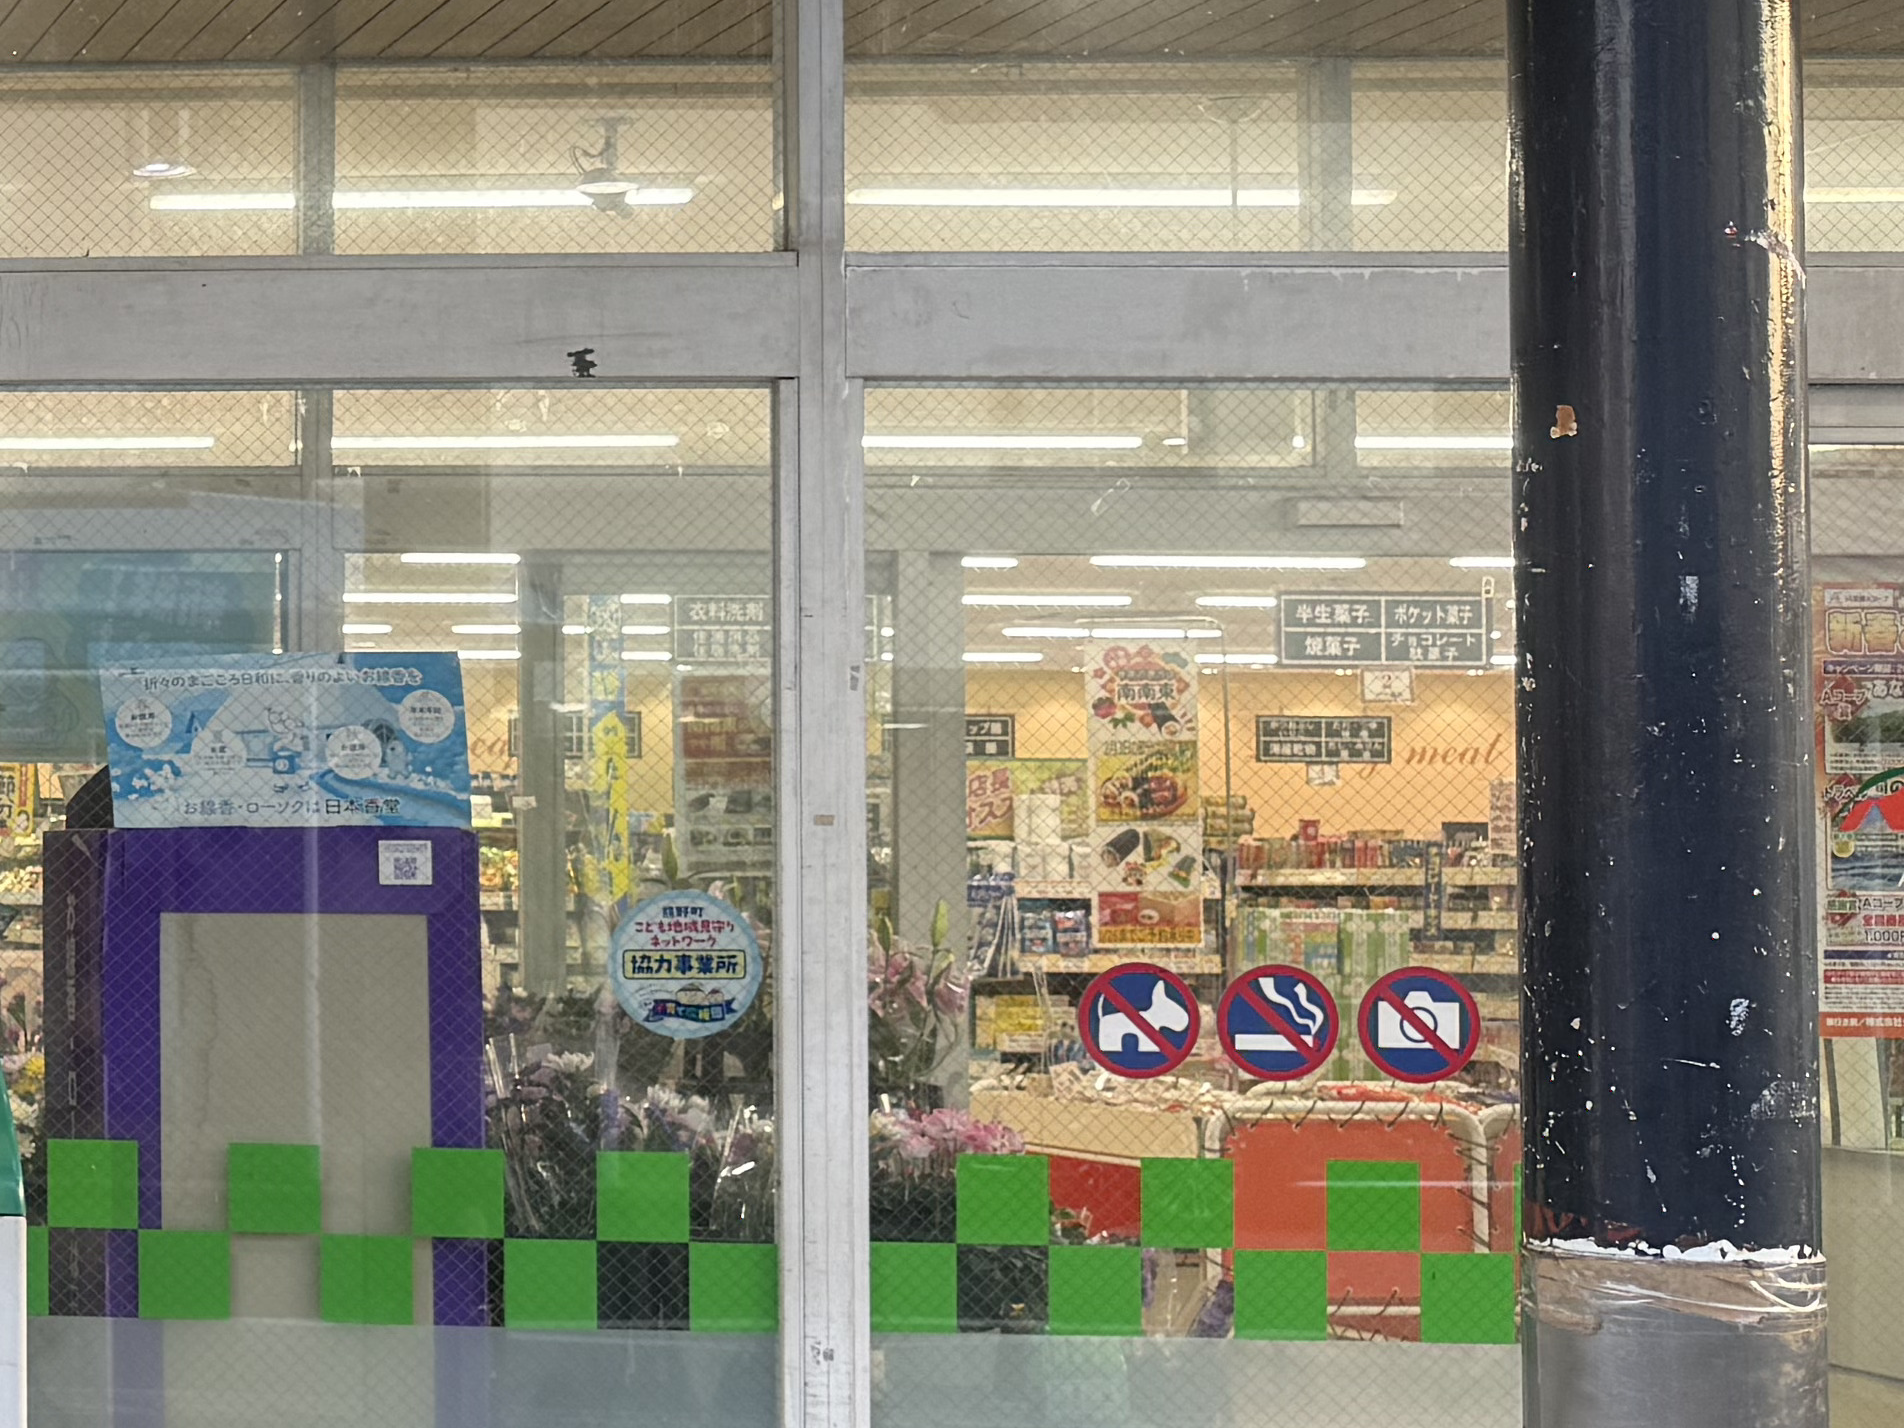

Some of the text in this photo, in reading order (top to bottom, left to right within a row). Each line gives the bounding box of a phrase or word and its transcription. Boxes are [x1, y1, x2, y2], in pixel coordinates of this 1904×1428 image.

[689, 602, 764, 621] 衣料洗剤
[1296, 603, 1473, 625] 半生菓子 ポケット菓子
[1304, 635, 1361, 657] 焼菓子
[1117, 682, 1177, 701] 南南東
[635, 920, 735, 934] こども地域見守り
[650, 934, 718, 948] ネットワーク
[631, 953, 739, 975] 協力事業所
